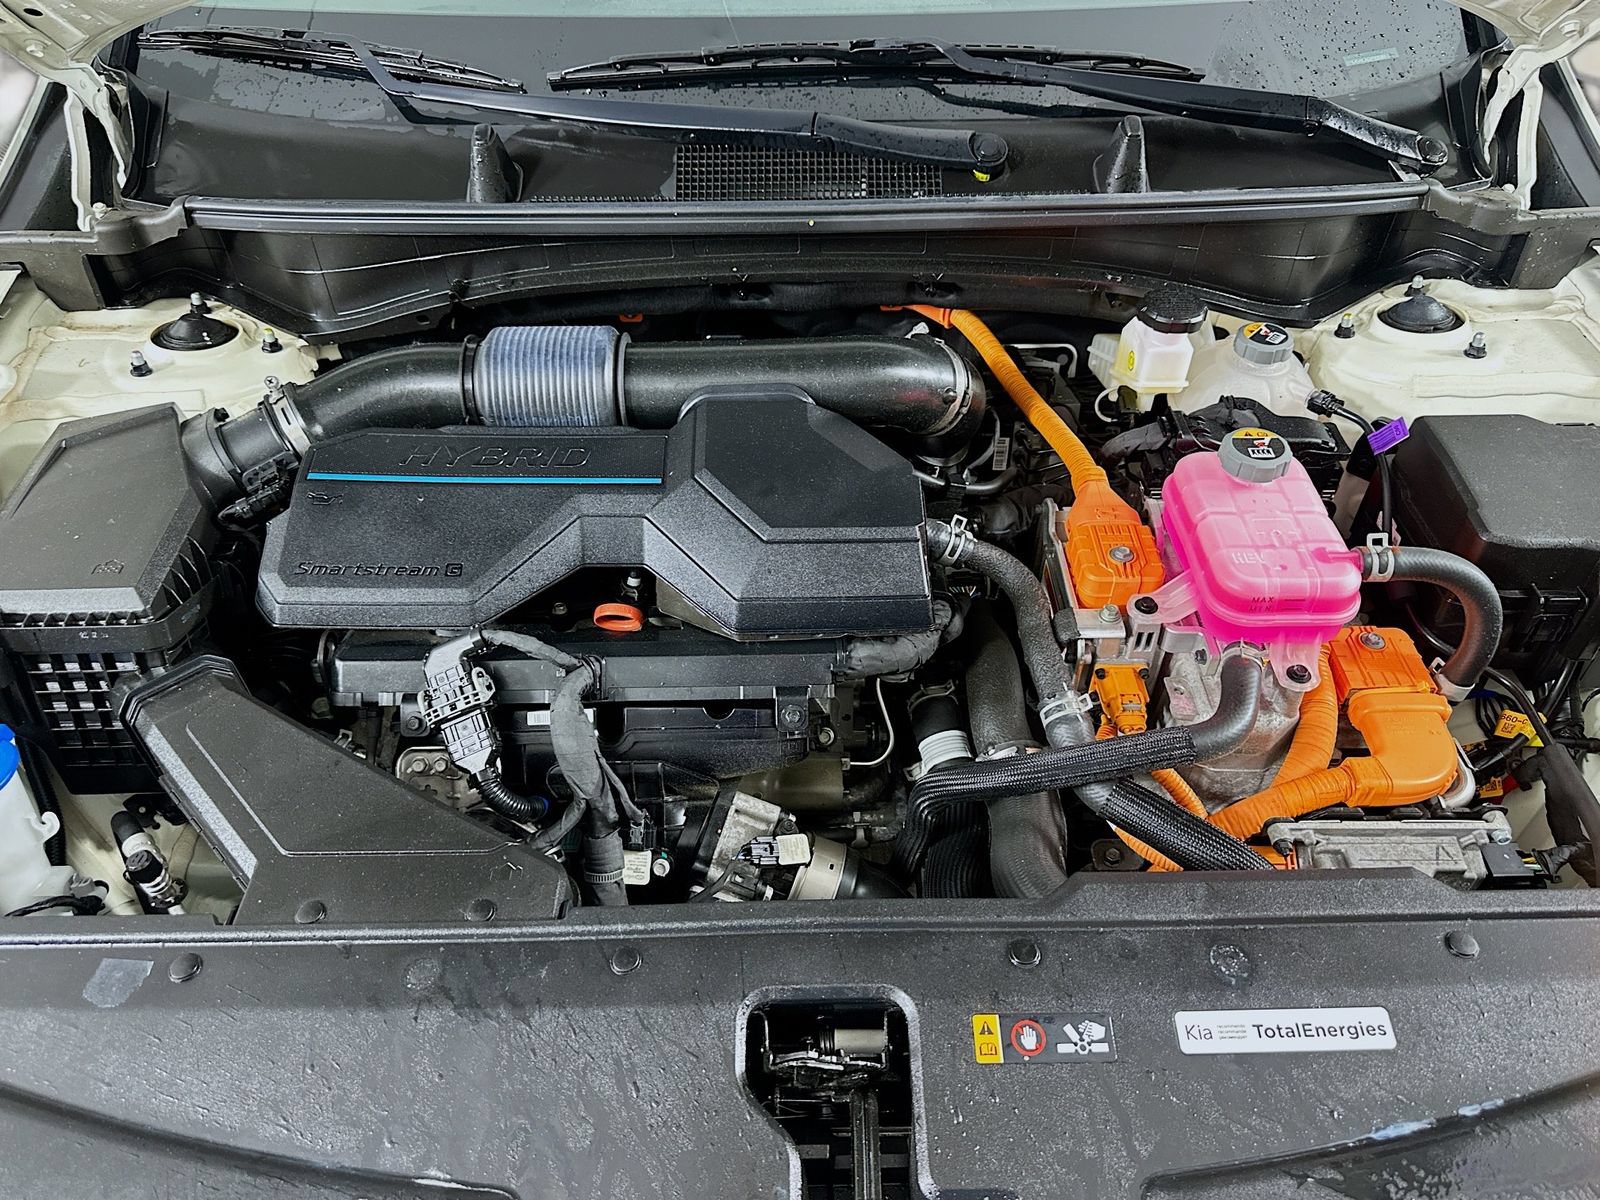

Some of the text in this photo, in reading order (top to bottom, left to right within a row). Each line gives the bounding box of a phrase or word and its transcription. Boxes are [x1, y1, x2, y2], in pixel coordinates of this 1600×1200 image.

[398, 445, 592, 468] HYBRID
[294, 561, 464, 577] Smartstream G
[1251, 596, 1275, 604] MAX
[1185, 1020, 1387, 1041] Kia TotalEnergies
